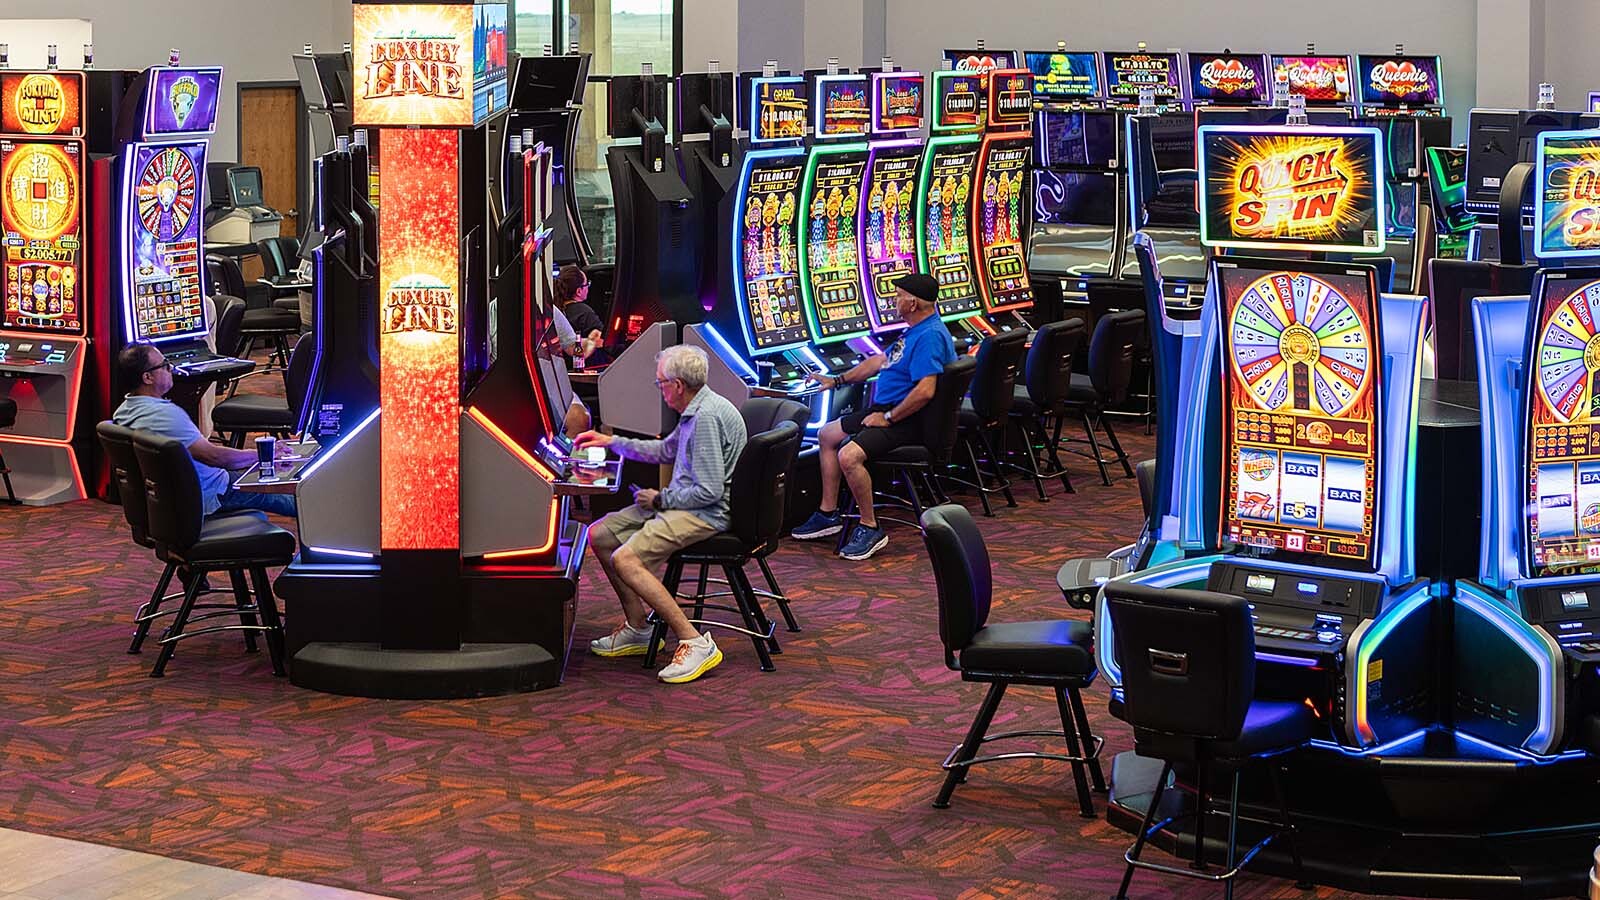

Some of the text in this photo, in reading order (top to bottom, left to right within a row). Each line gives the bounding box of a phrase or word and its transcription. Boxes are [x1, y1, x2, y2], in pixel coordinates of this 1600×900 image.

[371, 41, 460, 63] LUXURY
[363, 62, 464, 99] LINE
[1200, 62, 1255, 84] Queenie
[1371, 64, 1428, 87] Queenie
[21, 83, 59, 99] FORTUNE
[773, 89, 795, 101] GRAND
[22, 107, 58, 124] MINT
[31, 152, 49, 178] 招
[1239, 147, 1340, 199] QUICK
[1235, 191, 1338, 228] SPIN
[1260, 282, 1276, 303] 50
[1276, 276, 1294, 310] 225
[1296, 278, 1305, 298] 30
[1247, 294, 1273, 321] 200
[1324, 298, 1341, 314] 40
[1239, 310, 1258, 326] 25
[1327, 314, 1354, 332] 100
[1558, 311, 1574, 328] 50
[1236, 330, 1265, 342] 500
[1543, 350, 1561, 360] 25
[1543, 364, 1571, 381] 500
[1296, 423, 1306, 440] 2
[1242, 459, 1274, 471] WHEEL
[1286, 463, 1317, 476] BAR
[1329, 488, 1360, 501] BAR
[1542, 496, 1571, 506] BAR
[1285, 504, 1316, 517] BR
[1290, 536, 1300, 548] $1
[1337, 544, 1359, 555] $0.00
[1590, 547, 1600, 557] $1
